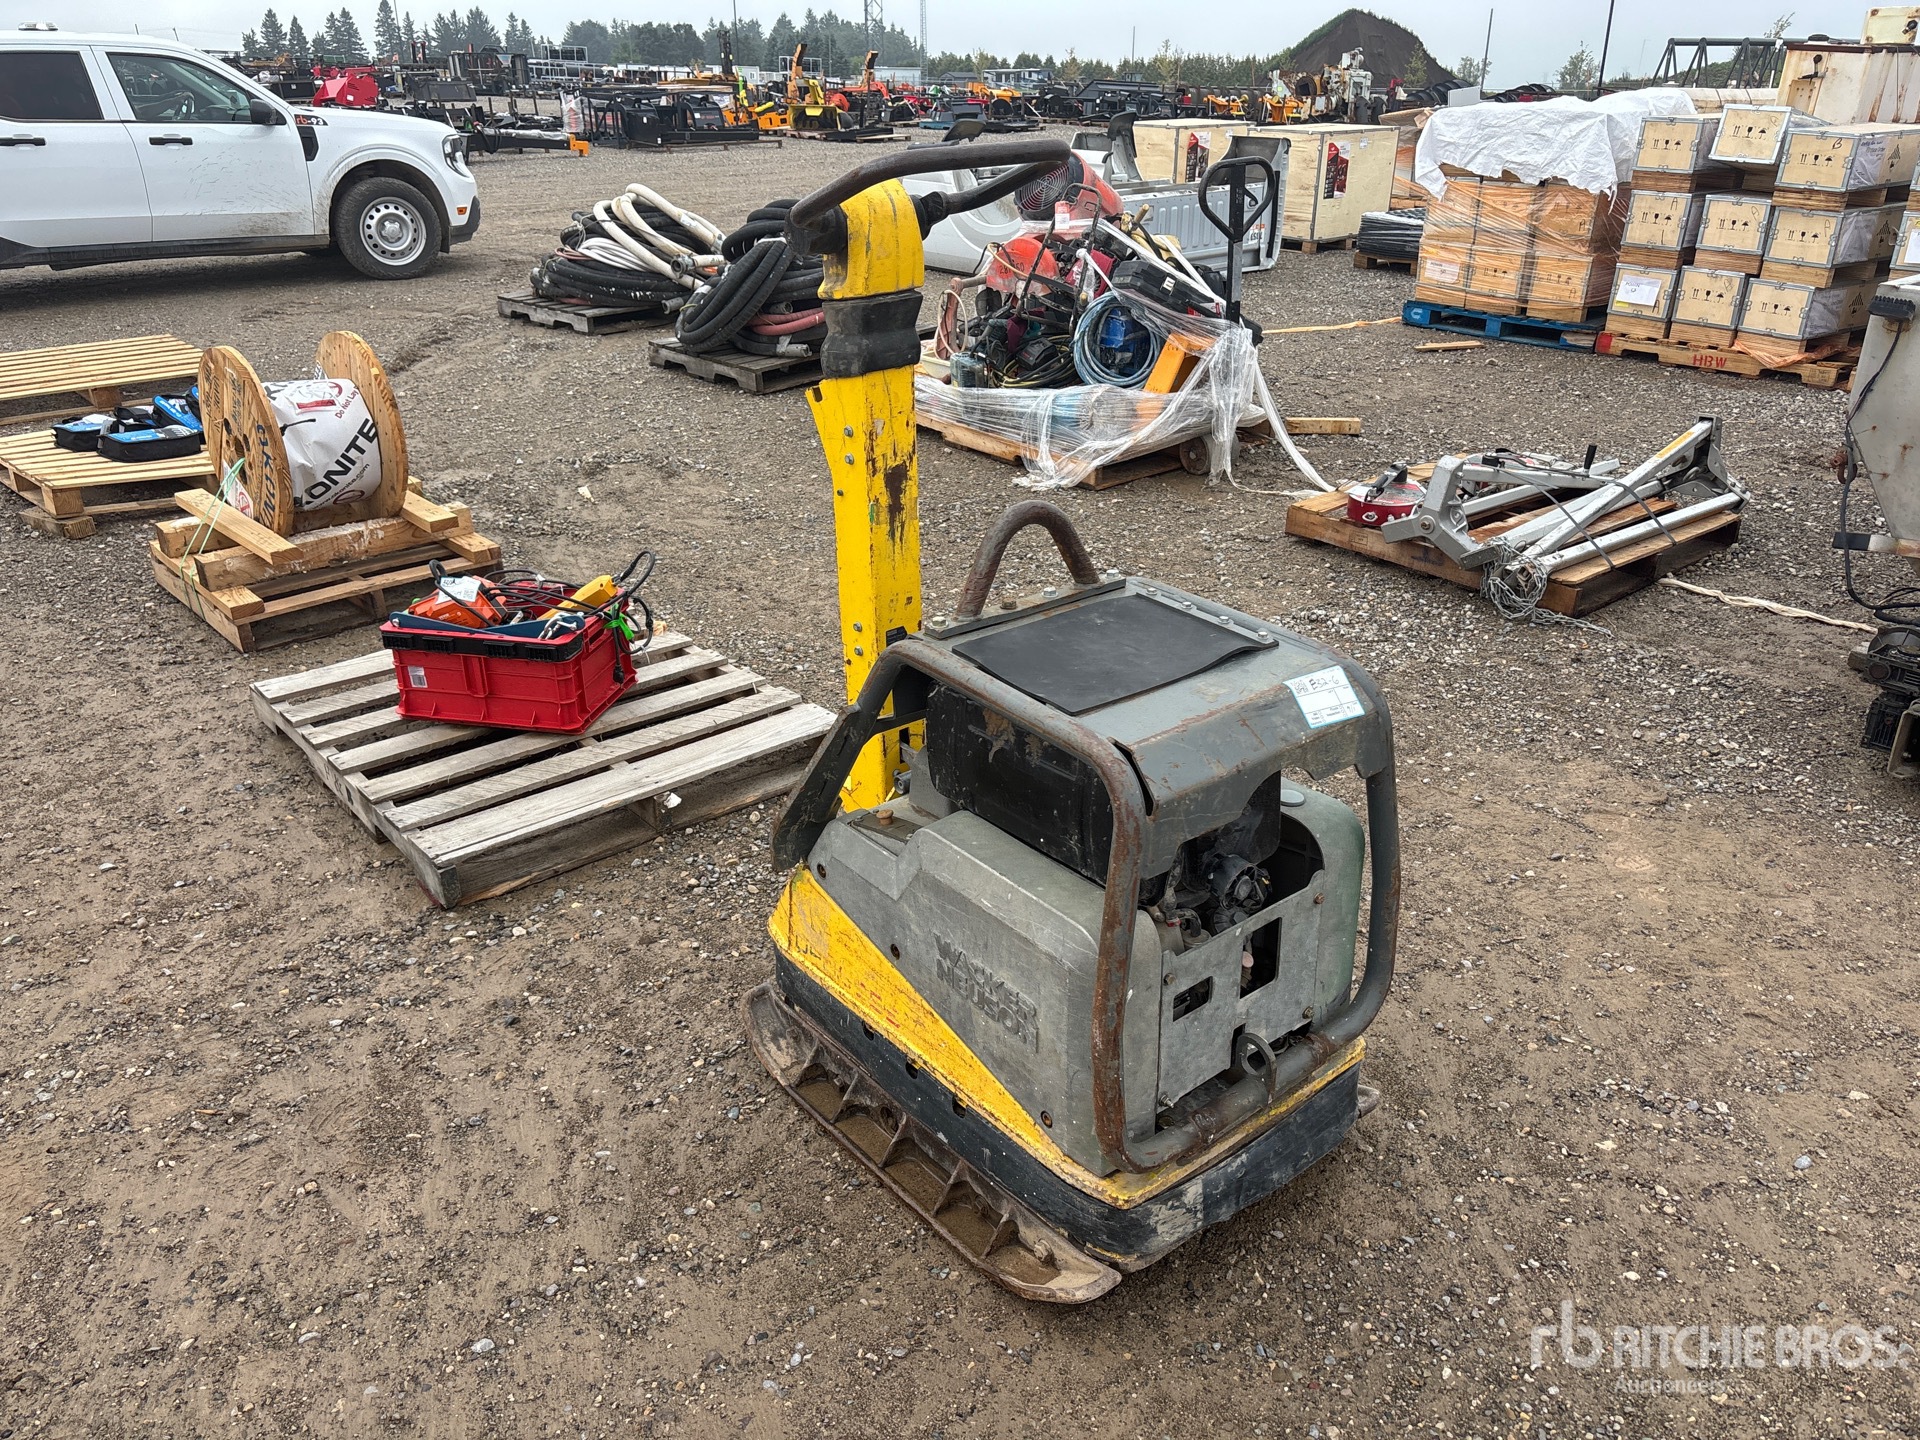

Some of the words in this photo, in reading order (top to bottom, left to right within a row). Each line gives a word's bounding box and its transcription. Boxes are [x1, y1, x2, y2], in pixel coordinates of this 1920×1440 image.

[1670, 197, 1678, 211] A
[1652, 299, 1660, 314] A
[1692, 354, 1727, 369] HBW
[932, 931, 1040, 1032] WACKER
[936, 957, 1040, 1054] NEUSON
